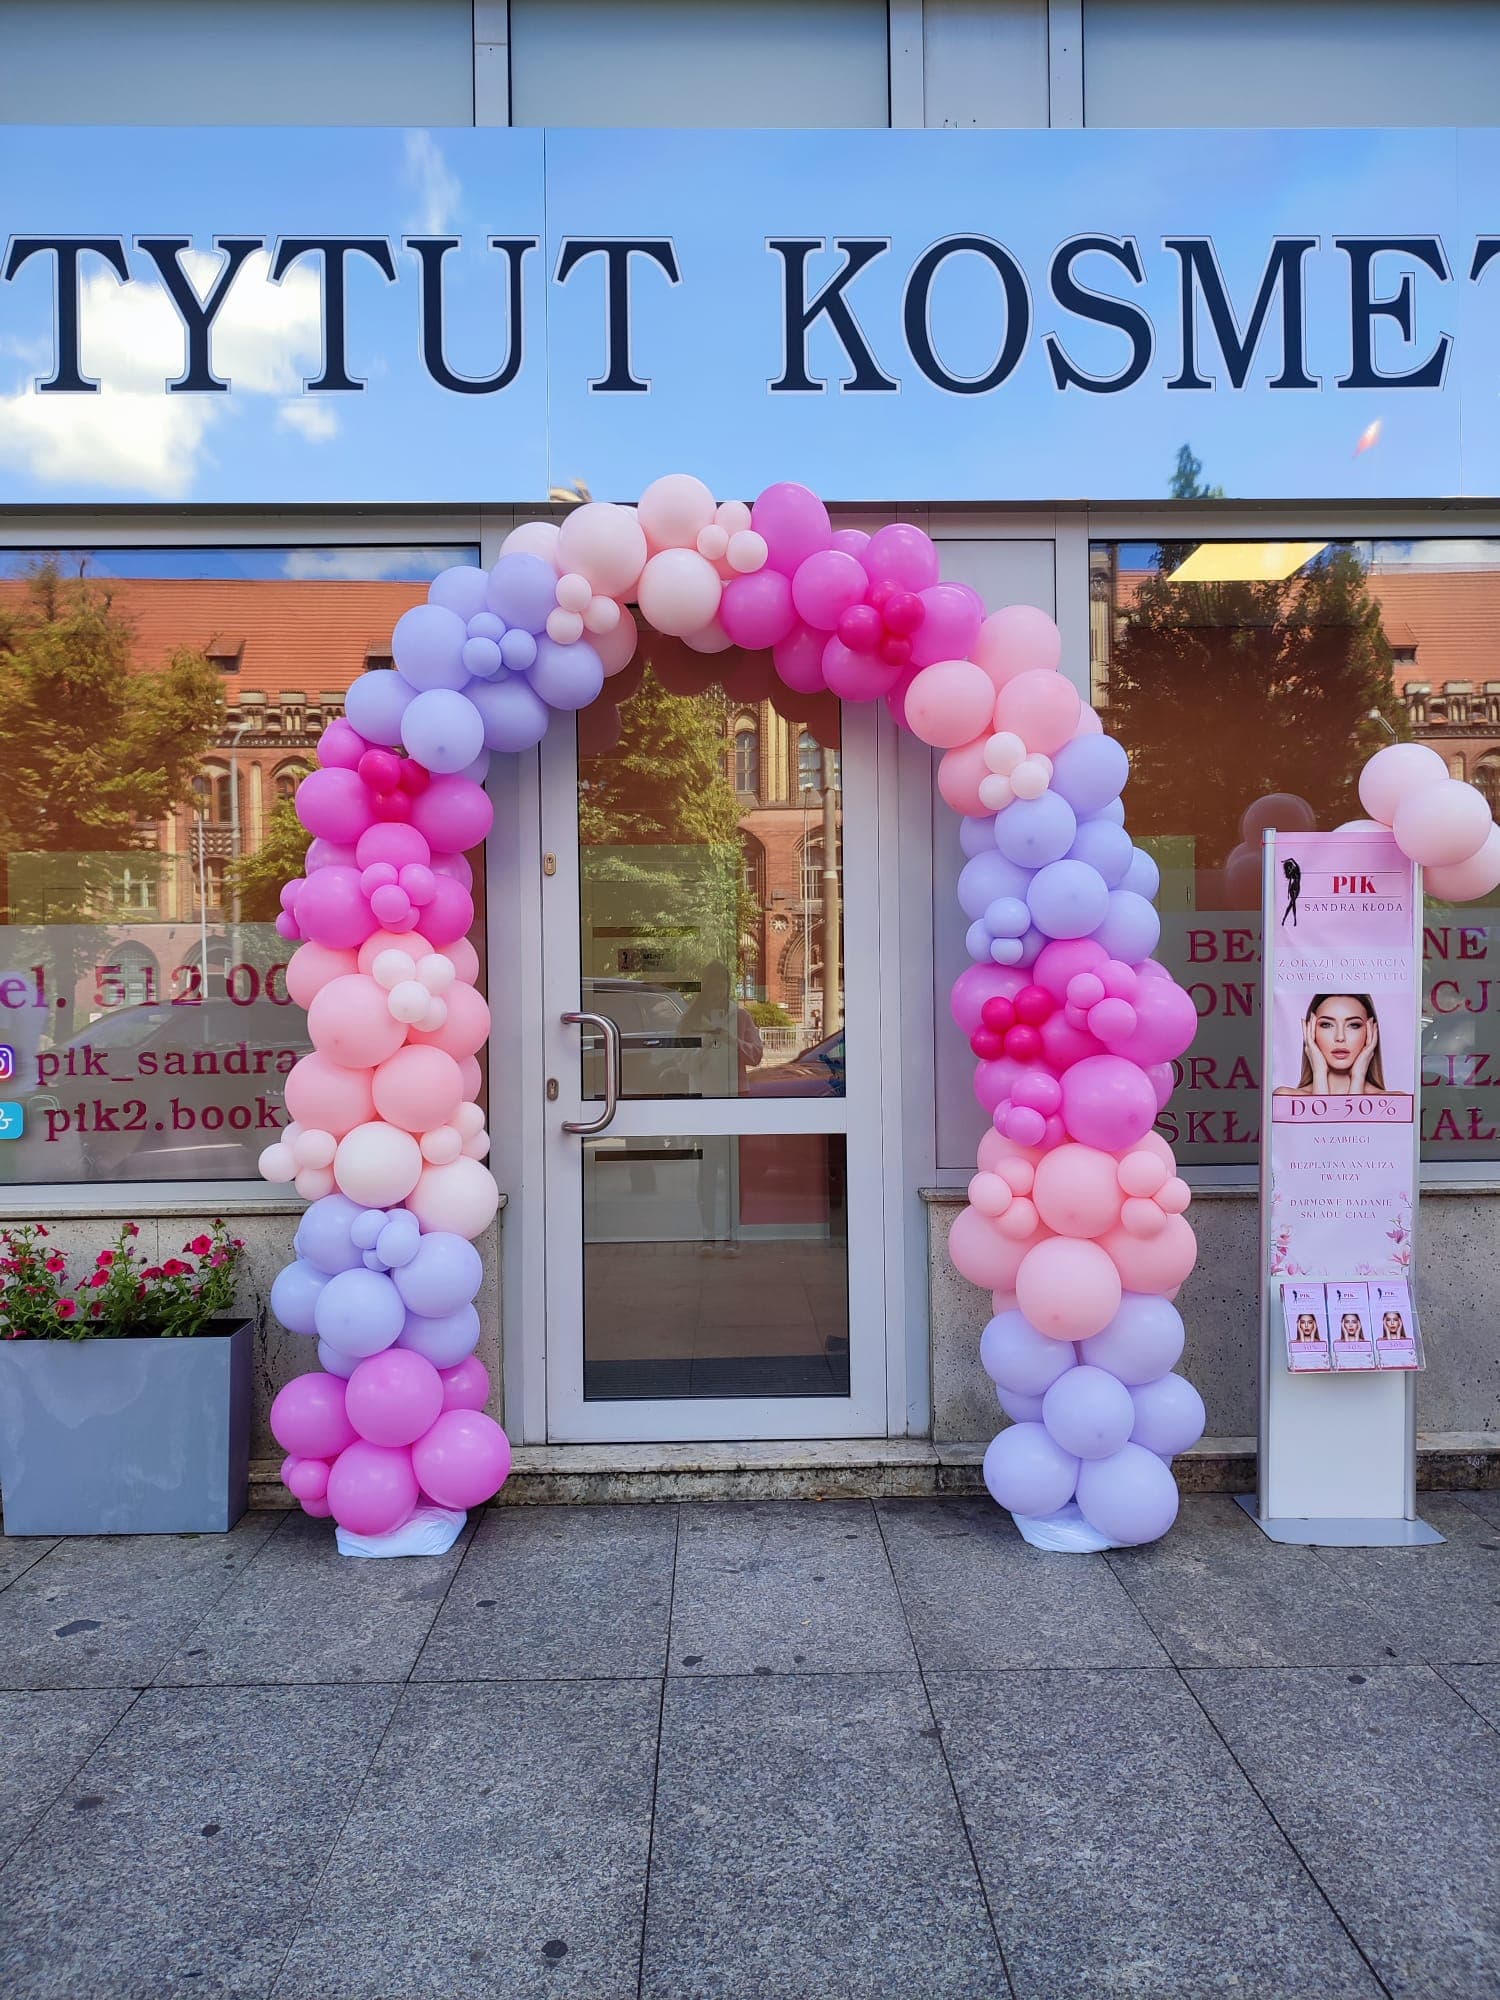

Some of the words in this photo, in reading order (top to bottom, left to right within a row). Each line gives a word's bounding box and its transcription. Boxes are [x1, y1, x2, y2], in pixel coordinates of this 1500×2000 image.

[1333, 876, 1377, 894] PIK
[1304, 903, 1356, 912] SANDRA
[1362, 903, 1403, 912] KŁODA
[93, 963, 203, 1008] 512
[43, 1096, 293, 1142] pik2.book
[1313, 1136, 1327, 1144] NA
[1329, 1136, 1371, 1144] ZABIEGI
[1320, 1173, 1361, 1181] TWARZY
